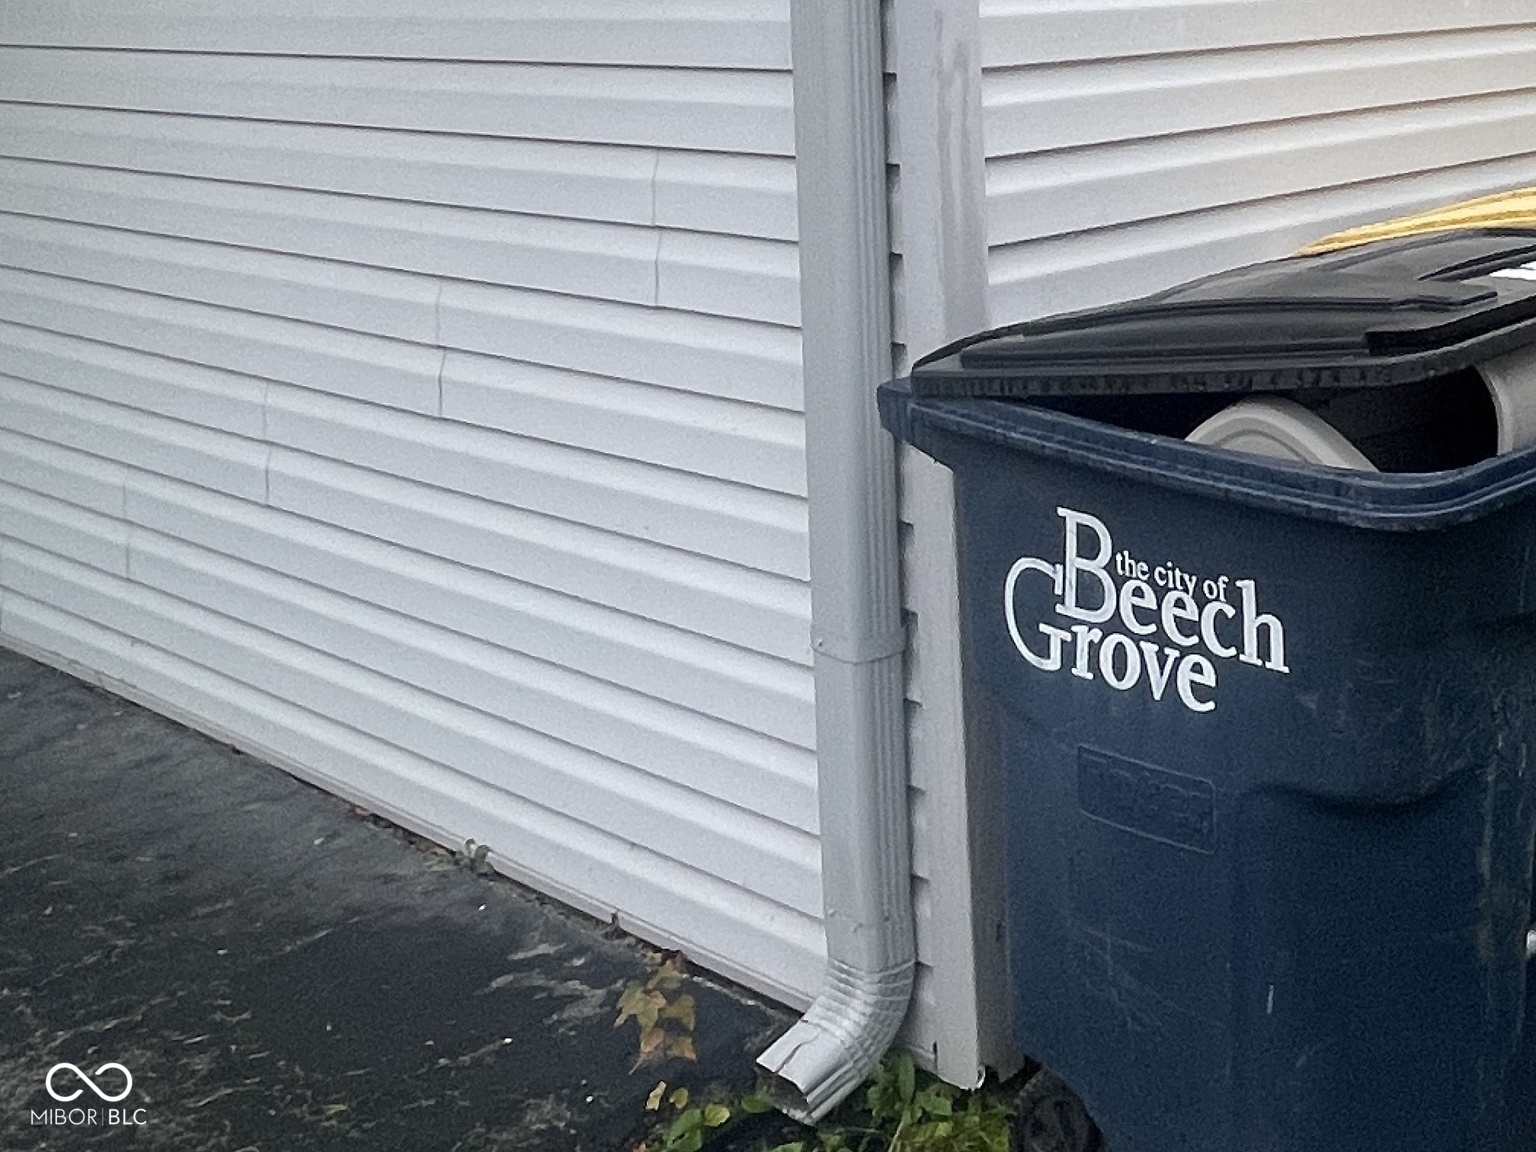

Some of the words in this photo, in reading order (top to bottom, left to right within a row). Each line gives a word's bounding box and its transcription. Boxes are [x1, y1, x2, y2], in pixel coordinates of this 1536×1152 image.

[1004, 556, 1217, 712] Grove
[1055, 506, 1290, 673] Beech
[1115, 550, 1150, 580] the
[1153, 561, 1197, 597] city
[1202, 575, 1229, 602] of
